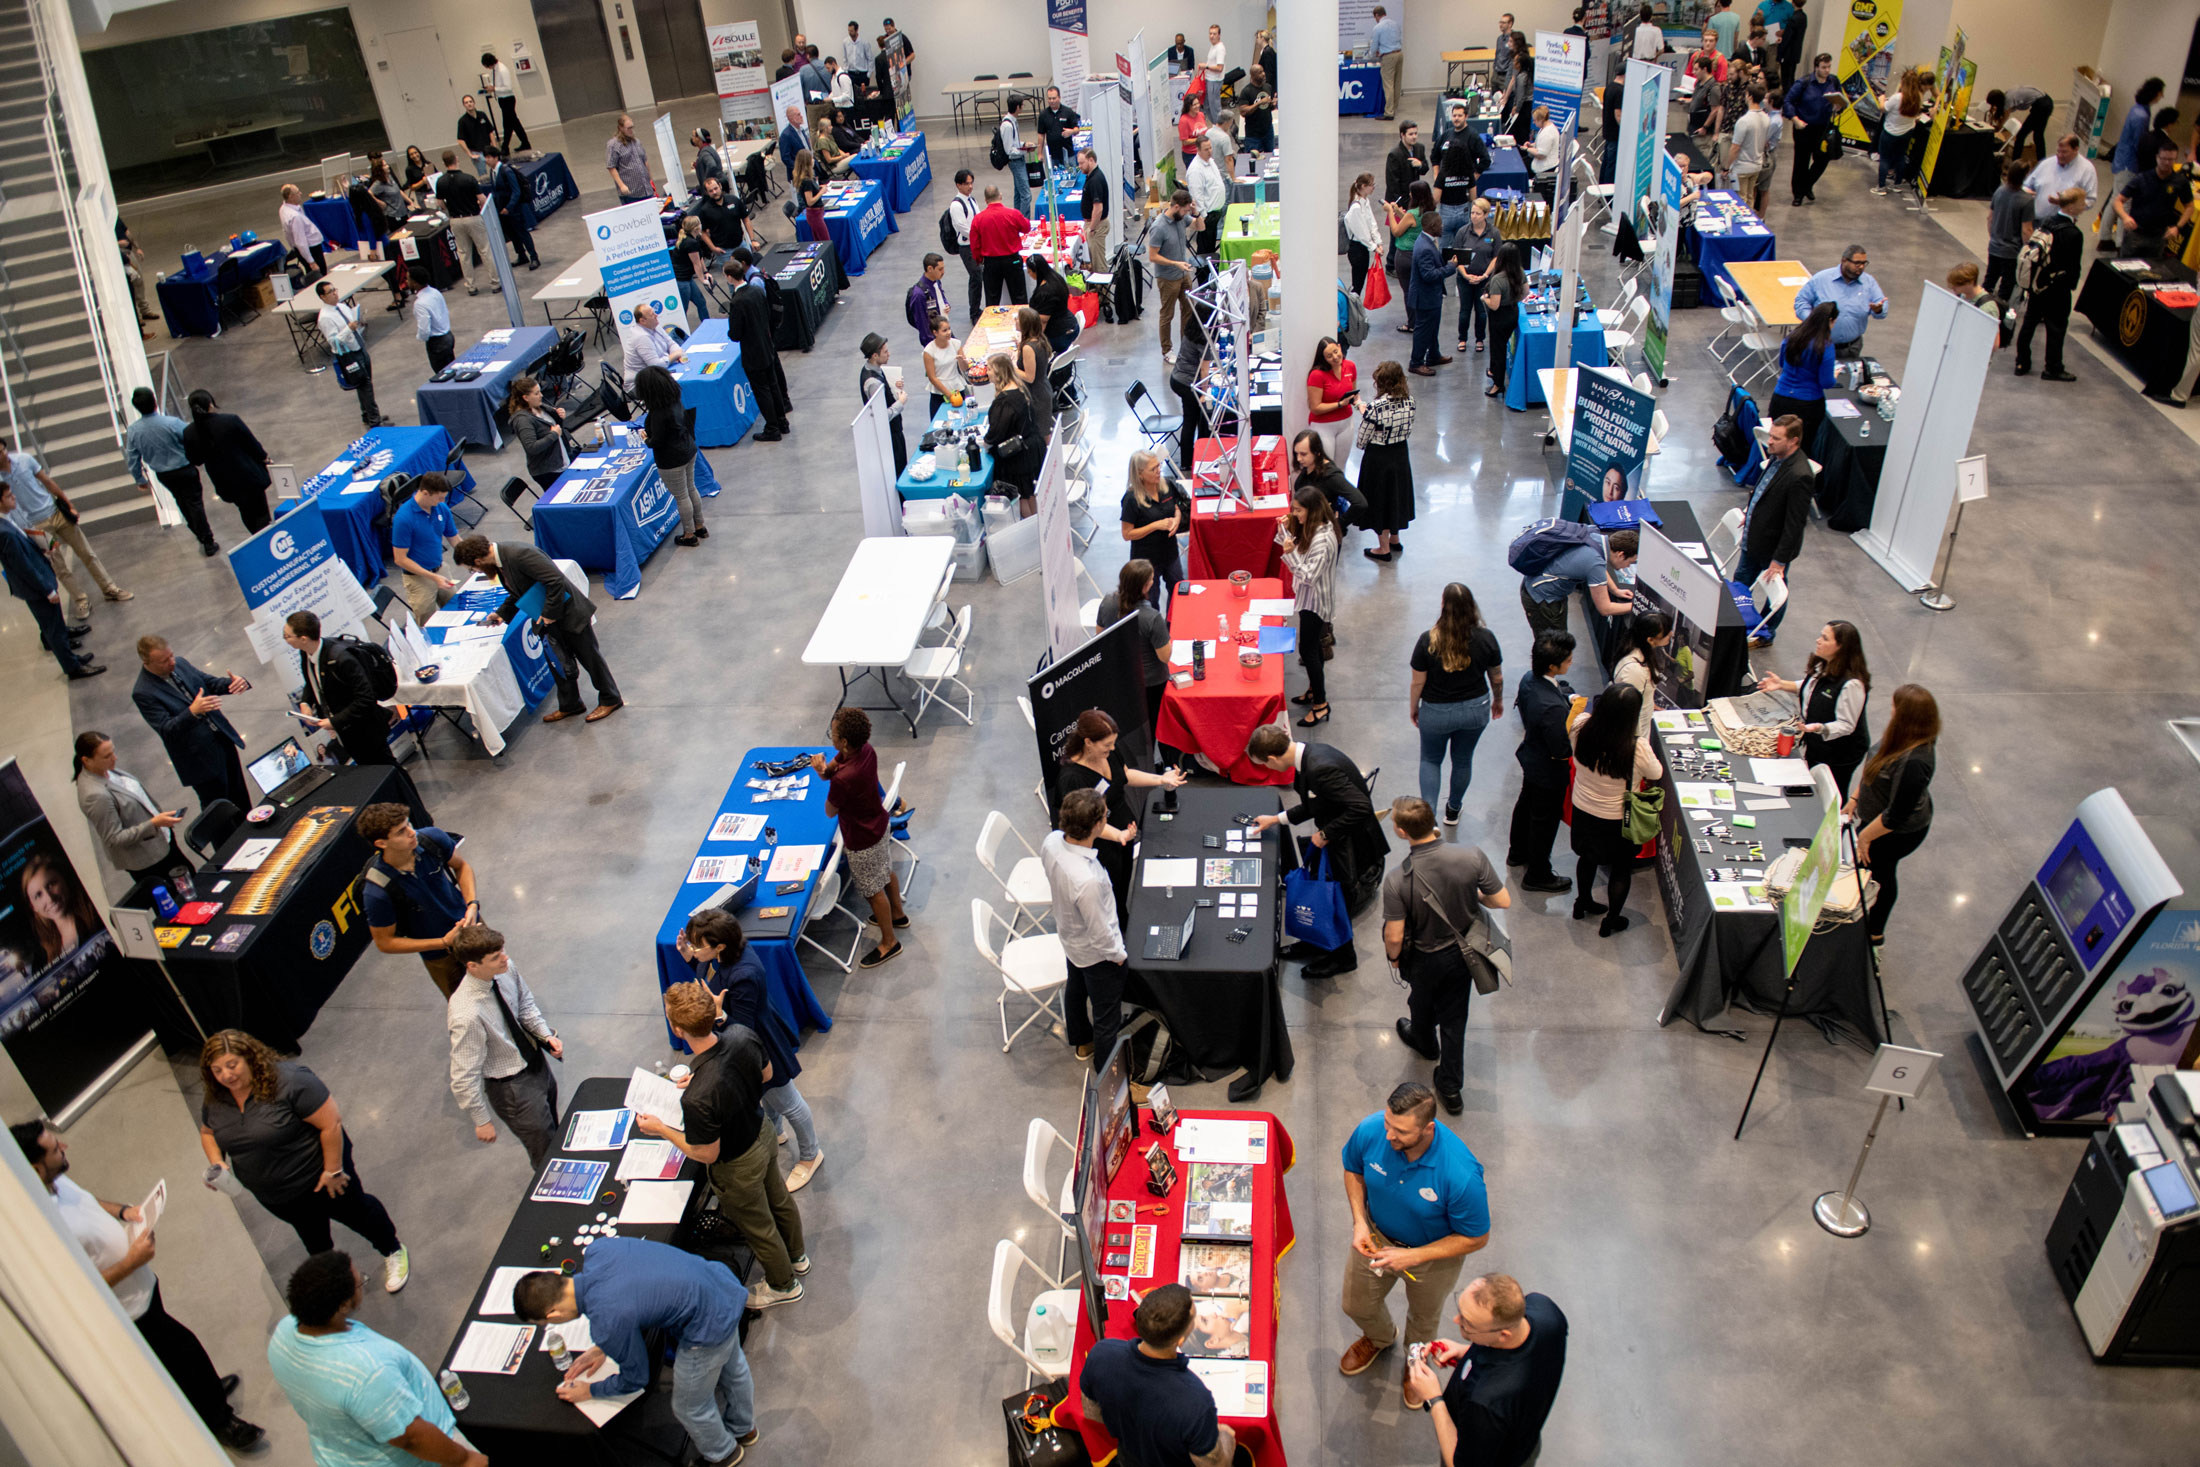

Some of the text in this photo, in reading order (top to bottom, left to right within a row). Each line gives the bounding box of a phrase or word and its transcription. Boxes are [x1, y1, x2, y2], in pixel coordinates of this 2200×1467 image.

[1854, 1, 1875, 13] GMF
[724, 33, 757, 44] SOULE
[613, 215, 652, 234] cowbell
[612, 248, 638, 260] Perfect
[638, 241, 660, 252] Match
[617, 241, 629, 251] and
[1577, 396, 1646, 436] BUILD A FUTURE
[1583, 411, 1633, 443] PROTECTING
[1575, 439, 1587, 450] WITH
[1590, 425, 1638, 458] THE NATION
[1598, 441, 1618, 458] CAREERS
[282, 478, 289, 487] 2
[1968, 474, 1975, 485] 7
[639, 477, 668, 518] ASH GR
[251, 538, 327, 593] CUSTOM MANUFACTURING
[263, 554, 324, 597] & ENGINEERING, INC.
[269, 568, 331, 613] Use Our Expertise to
[1660, 573, 1687, 599] MASONITE
[279, 579, 329, 618] Design and Build
[1634, 589, 1650, 605] OPEN
[1055, 652, 1102, 688] MACQUARIE
[24, 839, 36, 850] the
[133, 927, 143, 941] 3
[2151, 942, 2190, 950] FLORIDA
[41, 962, 52, 975] LIKE
[52, 957, 60, 966] NO
[28, 1013, 48, 1033] FIDELITY
[53, 992, 74, 1012] BRAVERY
[78, 968, 100, 991] INTEGRITY
[1892, 1066, 1909, 1079] 6
[1130, 1238, 1150, 1275] Semper
